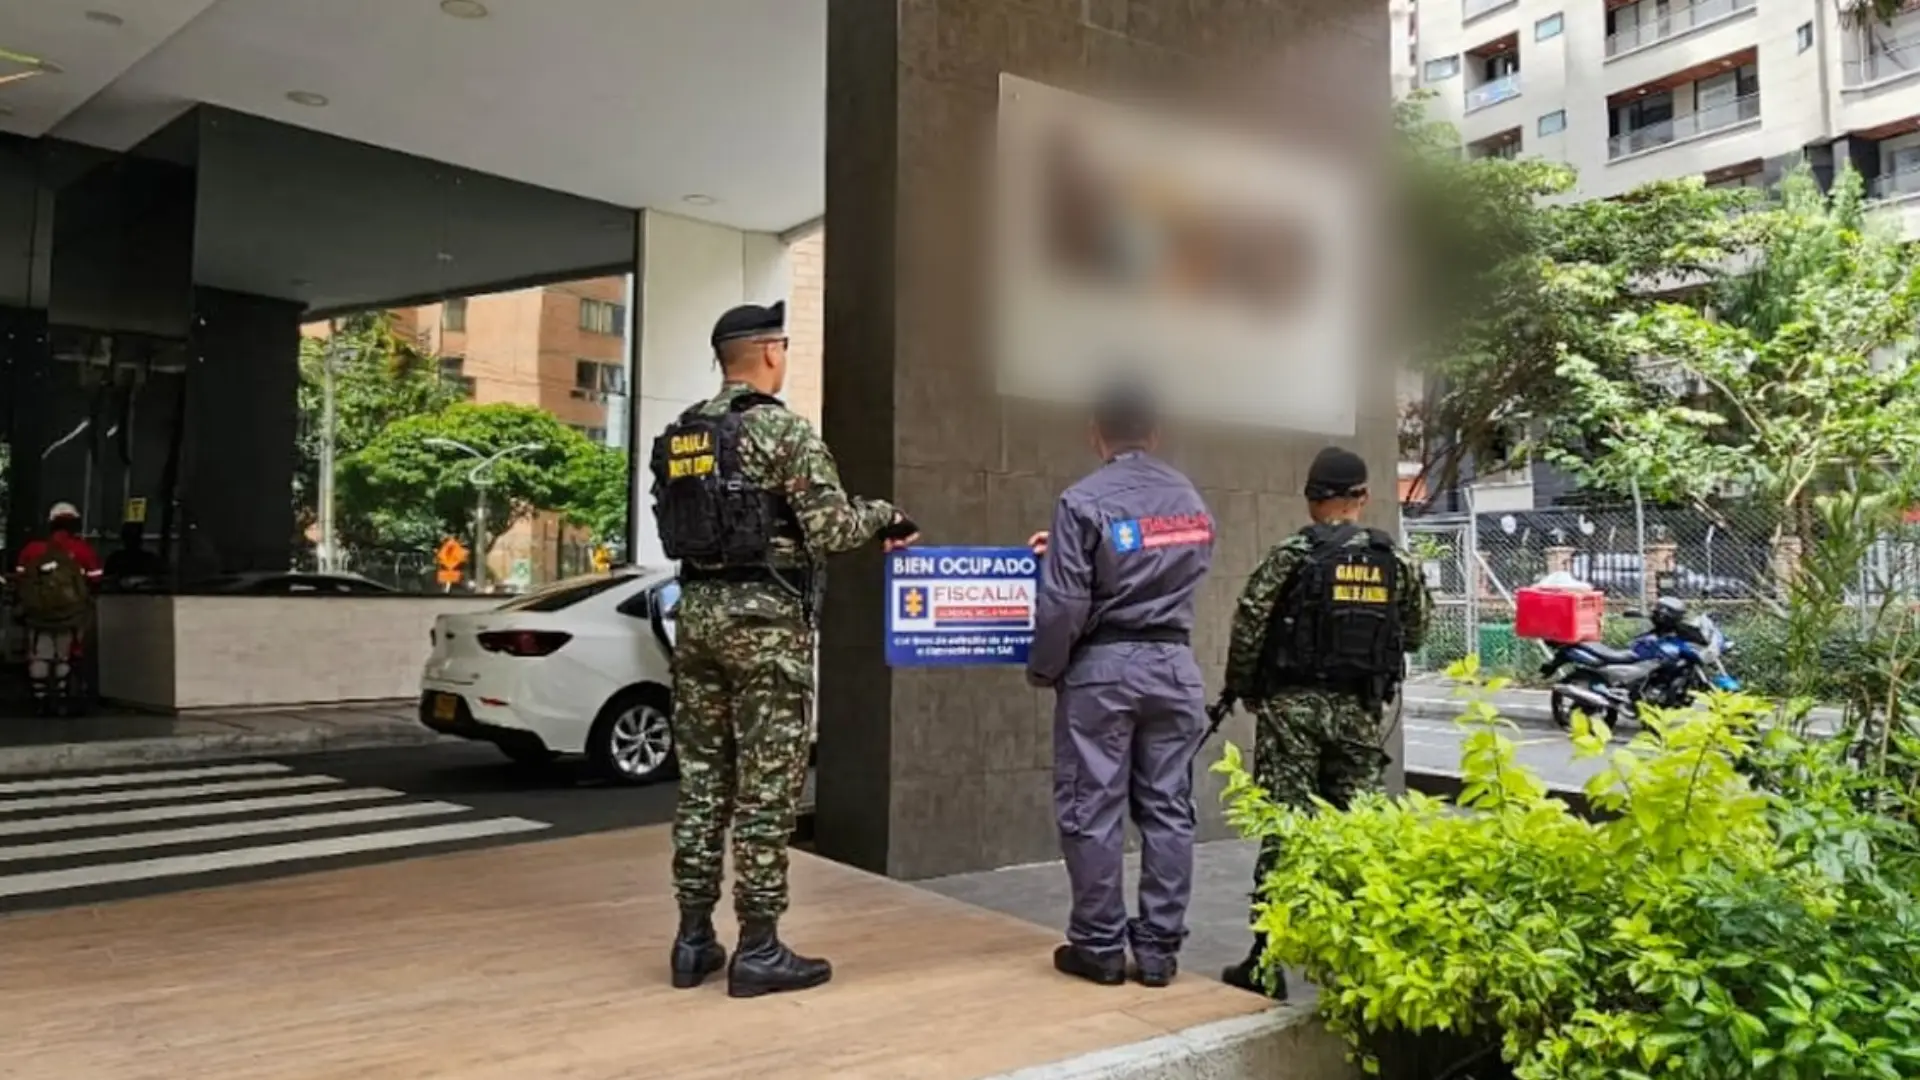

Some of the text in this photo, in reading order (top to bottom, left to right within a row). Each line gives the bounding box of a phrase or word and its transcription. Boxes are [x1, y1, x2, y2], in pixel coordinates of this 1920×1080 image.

[671, 432, 710, 454] GAULA
[893, 557, 1036, 575] BIEN OCUPADO
[1335, 564, 1381, 582] GAULA
[934, 585, 1028, 601] FISCALÍA
